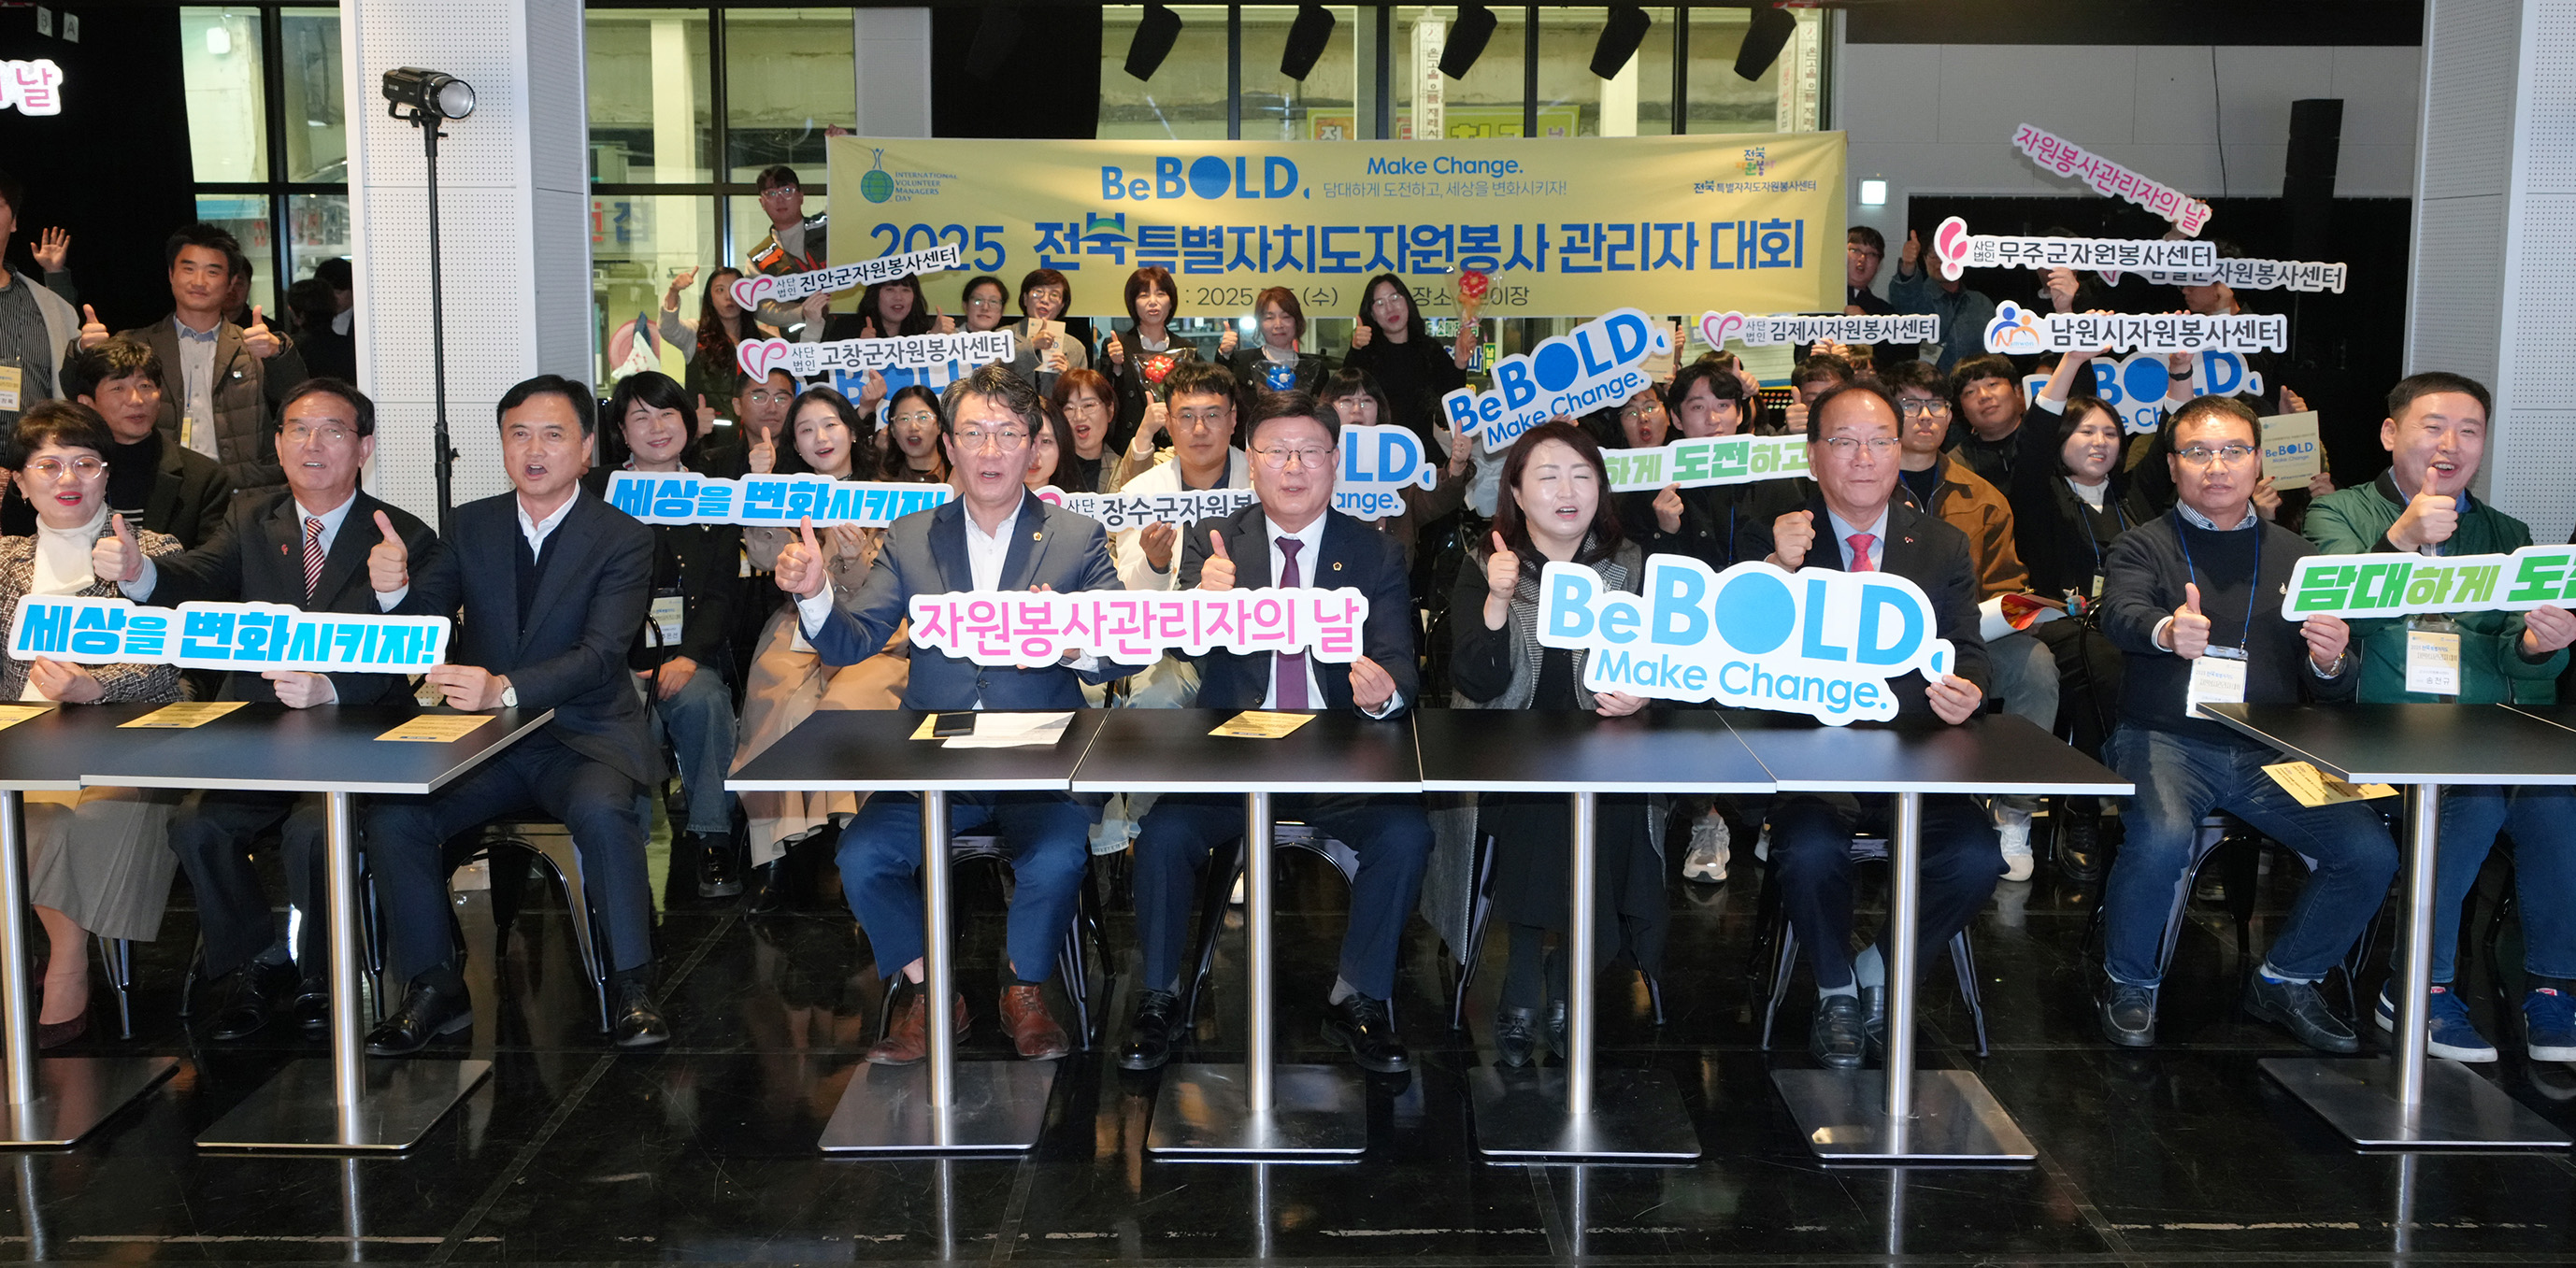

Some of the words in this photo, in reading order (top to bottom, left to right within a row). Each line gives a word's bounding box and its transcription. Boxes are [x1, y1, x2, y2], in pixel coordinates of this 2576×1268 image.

[67, 21, 76, 36] A
[16, 68, 52, 107] 날
[894, 171, 958, 179] INTERNATIONAL
[1367, 156, 1427, 175] Make
[1433, 156, 1524, 178] Change.
[1323, 181, 1380, 199] 담대하게
[1383, 181, 1443, 199] 도전하고,
[1446, 180, 1489, 197] 세상을
[1492, 180, 1567, 197] 변화시키자!
[2017, 127, 2181, 217] 자원봉사관리자의
[2182, 203, 2206, 232] 날
[894, 187, 939, 195] MANAGERS
[870, 223, 1006, 272] 2025
[1558, 221, 1699, 273] 관리자
[1710, 218, 1804, 269] 대회
[1974, 240, 1995, 251] 사단
[1998, 241, 2212, 267] 무주군자원봉사센터
[1974, 251, 1995, 263] 법인
[800, 247, 958, 292] 진안군자원봉사센터
[776, 278, 795, 288] 사단
[1746, 321, 1766, 331] 사단
[1770, 319, 1937, 341] 김제시자원봉사센터
[2051, 319, 2283, 348] 남원시자원봉사센터
[1746, 332, 1766, 343] 법인
[792, 347, 815, 359] 사단
[821, 335, 1011, 367] 고창군자원봉사센터
[793, 361, 816, 372] 법인
[1487, 410, 1546, 447] Make
[1551, 372, 1645, 416] Change.
[610, 478, 733, 518] 세상을
[1066, 498, 1095, 513] 사단
[2294, 563, 2501, 611] 담대하게
[2507, 555, 2576, 602] 도
[17, 604, 167, 656] 세상을
[179, 611, 439, 664] 변화시키자!
[919, 598, 1295, 658] 자원봉사관리자의
[1314, 597, 1360, 653] 날
[1595, 648, 1708, 691] Make
[1718, 660, 1888, 714] Change.
